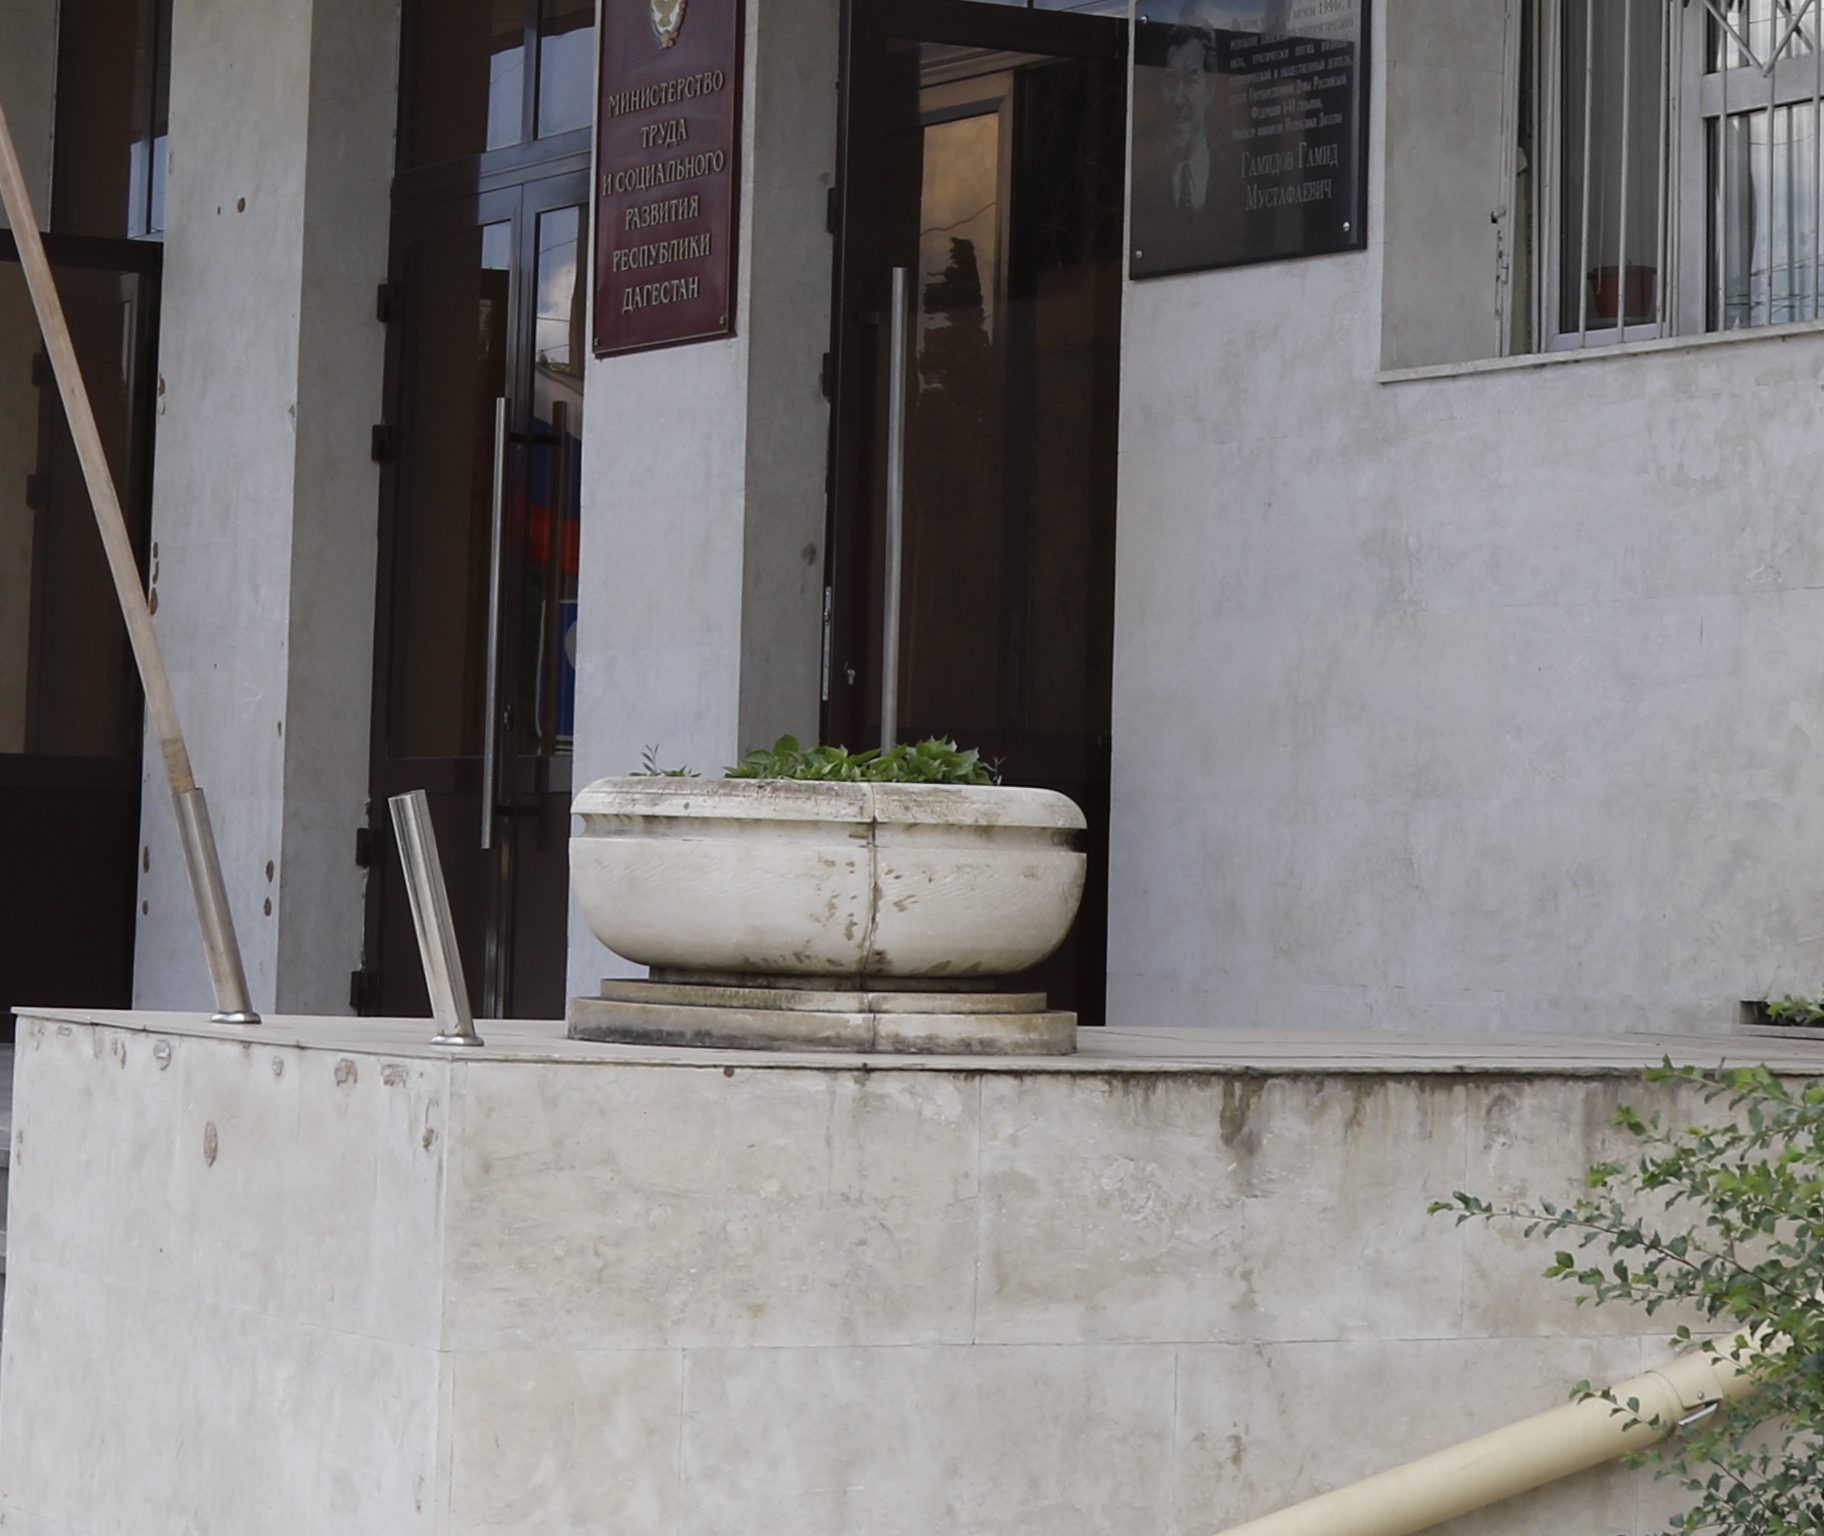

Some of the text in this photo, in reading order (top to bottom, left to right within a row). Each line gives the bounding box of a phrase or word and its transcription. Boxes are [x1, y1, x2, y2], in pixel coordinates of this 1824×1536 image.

[607, 69, 725, 118] МИНИСТЕРСТВО
[640, 117, 688, 149] ТРУДА
[602, 149, 725, 197] И СОЦИАЛЬНОГО
[624, 194, 700, 231] РАЗВИТИЯ
[612, 232, 712, 273] РЕСПУБЛИКИ
[621, 275, 700, 316] ДАГЕСТАН
